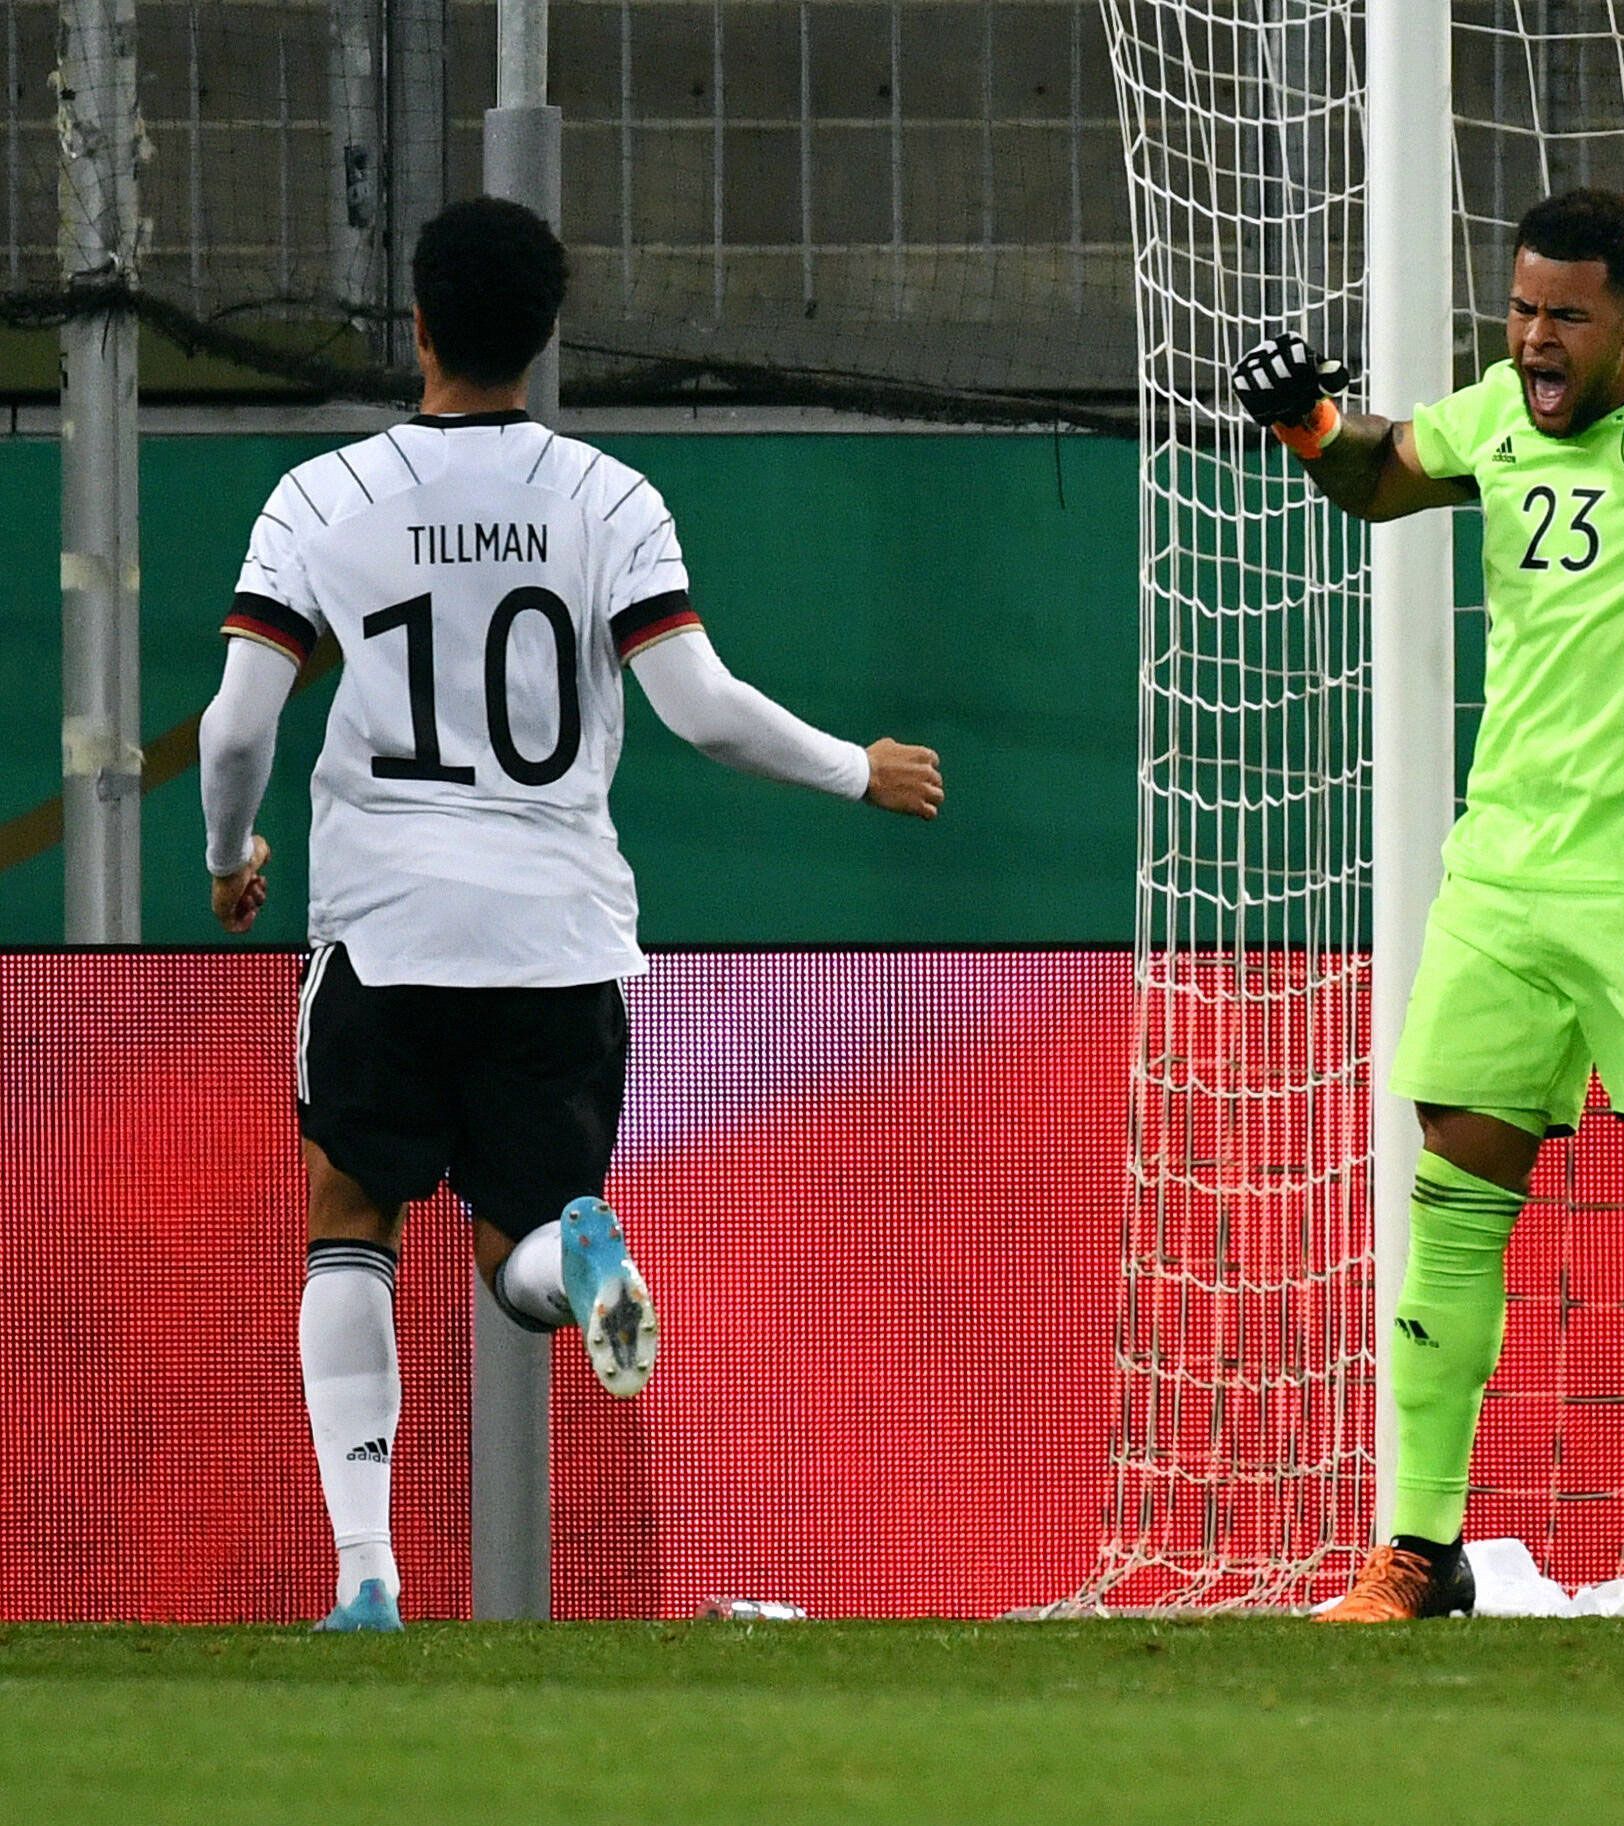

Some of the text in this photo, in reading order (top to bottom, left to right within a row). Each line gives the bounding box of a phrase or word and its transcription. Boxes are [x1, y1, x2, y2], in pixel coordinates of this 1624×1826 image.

[407, 522, 548, 565] TILLMAN
[1519, 486, 1605, 572] 23
[362, 586, 582, 787] 10
[346, 1451, 390, 1464] adida
